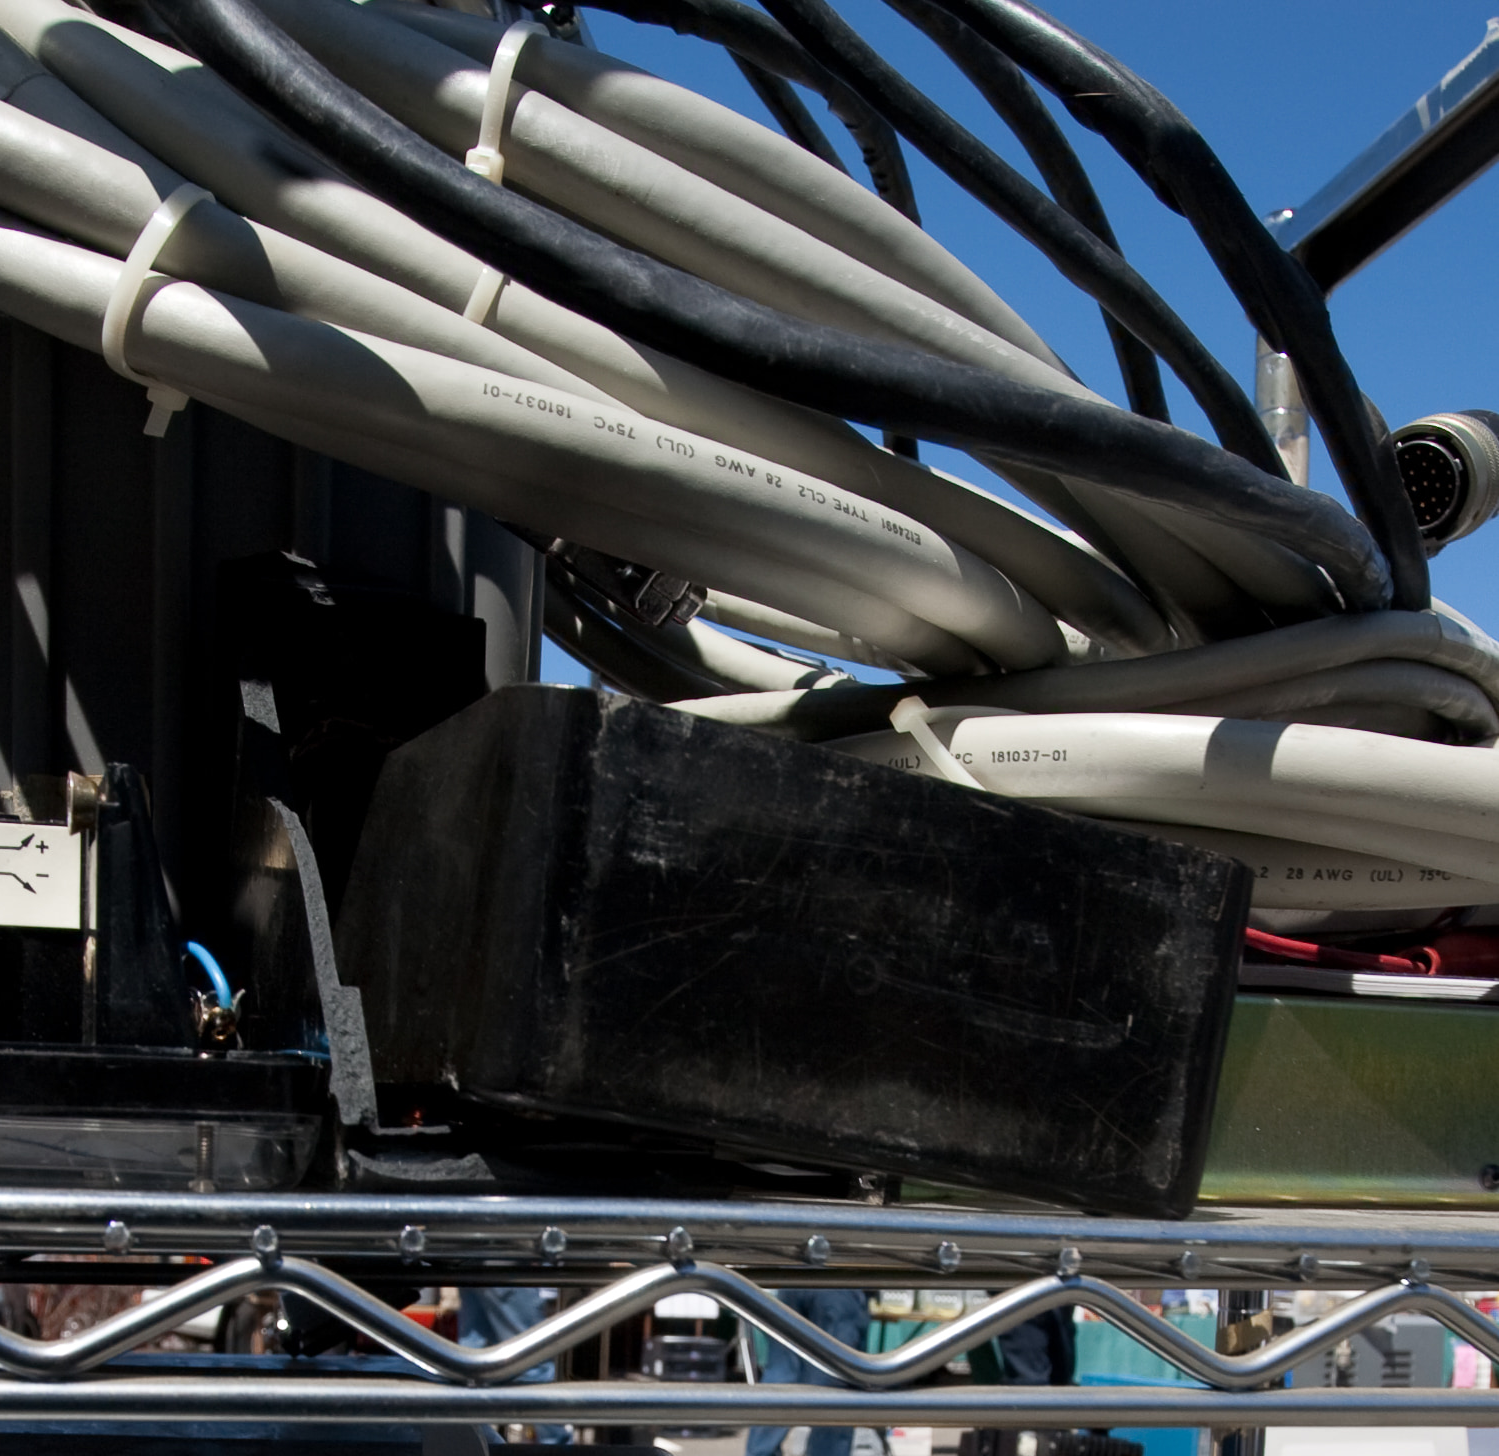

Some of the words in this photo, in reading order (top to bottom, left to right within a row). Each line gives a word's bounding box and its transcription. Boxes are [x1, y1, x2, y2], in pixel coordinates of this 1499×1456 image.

[481, 381, 573, 420] 181037-01
[656, 434, 696, 460] (UL)
[714, 454, 757, 479] AWG
[765, 471, 783, 490] 28
[797, 484, 826, 506] CL2
[833, 497, 869, 524] TYPE
[990, 749, 1068, 764] 181037-01
[1285, 867, 1304, 880] 28
[1312, 868, 1354, 882] AWG
[1369, 869, 1404, 883] (UL)
